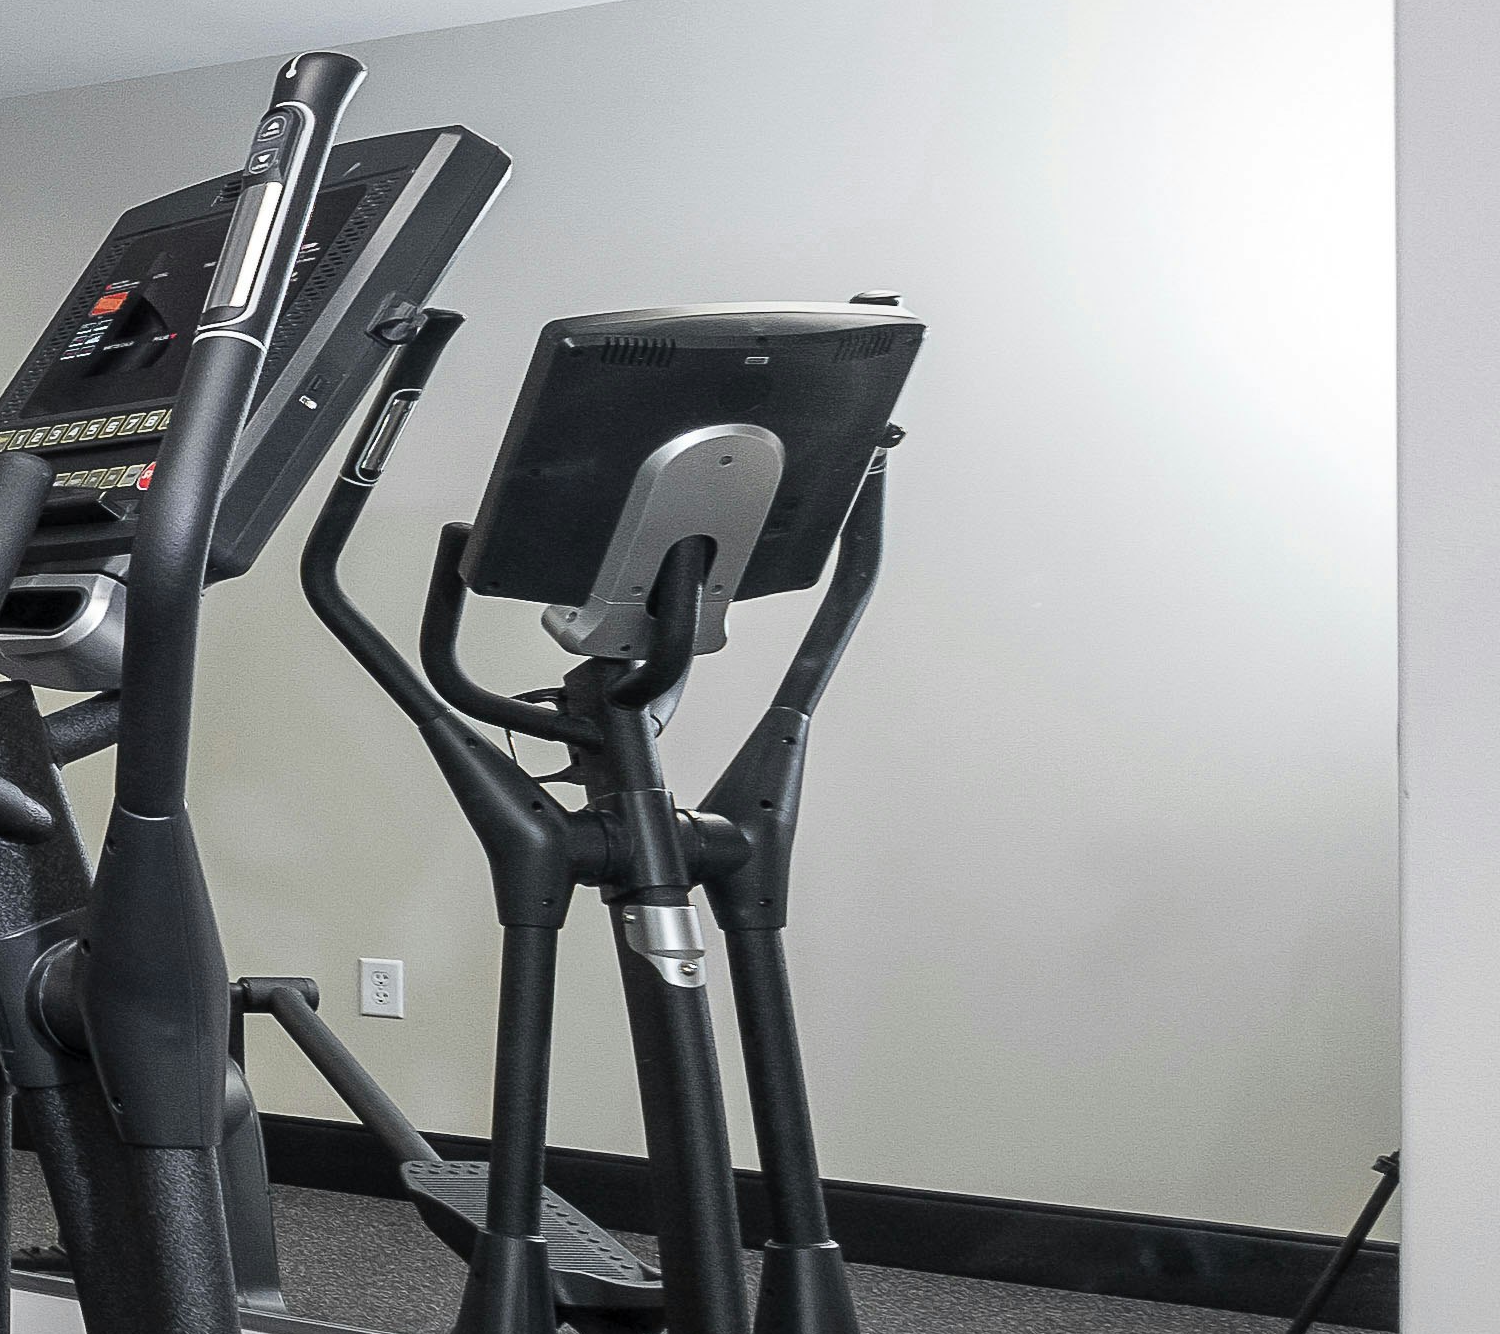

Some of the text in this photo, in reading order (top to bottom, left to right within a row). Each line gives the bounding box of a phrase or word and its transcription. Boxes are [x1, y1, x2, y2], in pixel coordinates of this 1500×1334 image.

[15, 434, 26, 445] 1
[30, 432, 44, 443] 2
[49, 429, 62, 440] 3
[86, 424, 100, 435] 5
[105, 421, 120, 433] 6
[125, 417, 140, 430] 7
[143, 415, 159, 427] 8
